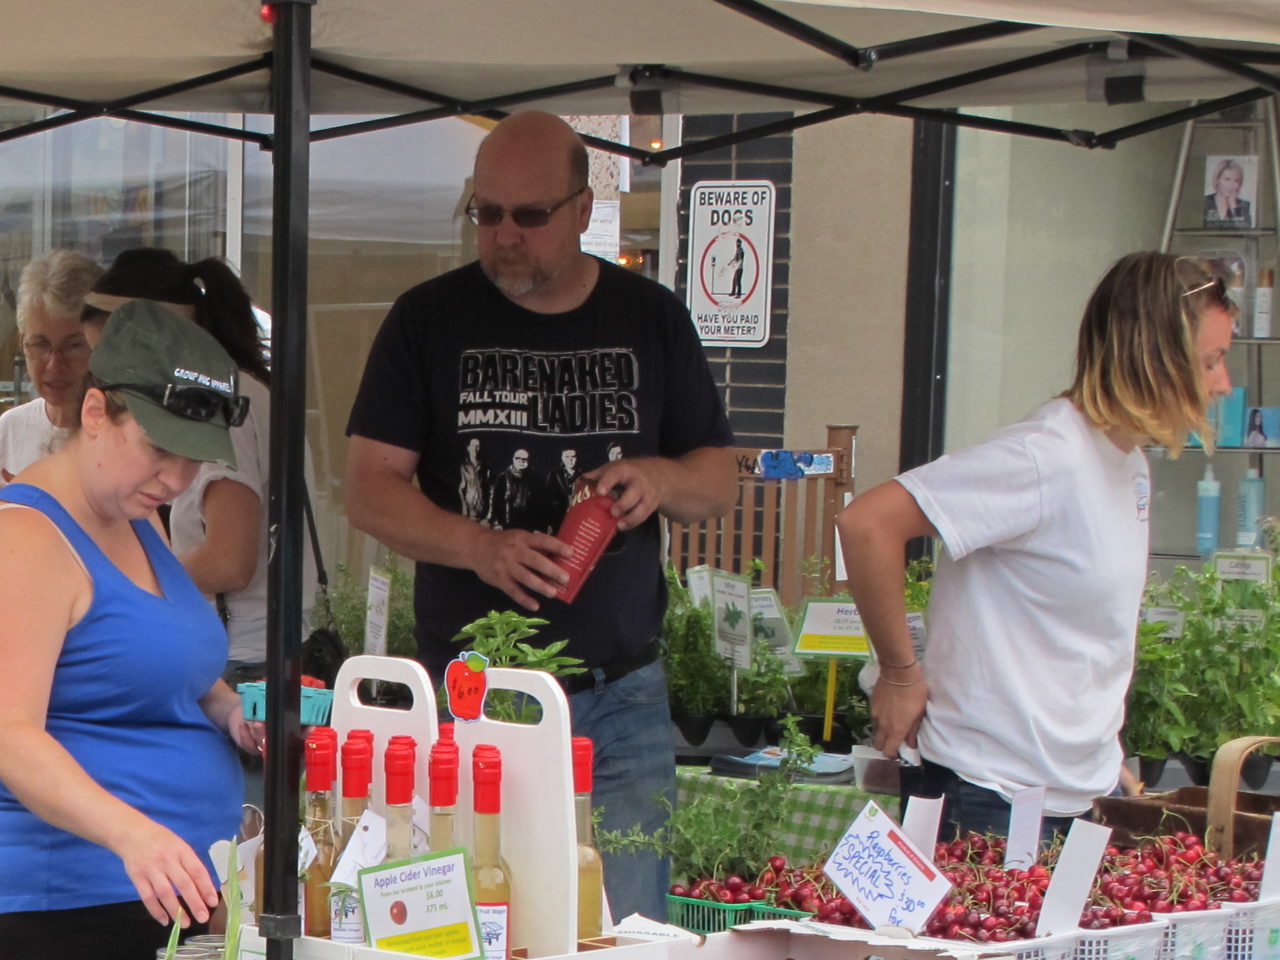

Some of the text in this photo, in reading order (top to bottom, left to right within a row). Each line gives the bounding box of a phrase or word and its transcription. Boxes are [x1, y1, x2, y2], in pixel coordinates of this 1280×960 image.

[699, 191, 767, 206] BEWARE OF
[697, 314, 759, 324] HAVE YOU PAID
[699, 325, 757, 336] YOUR METER?
[460, 352, 639, 394] BARENAKED
[460, 391, 529, 405] FALL TOUR
[458, 409, 528, 427] MMXIII
[531, 393, 639, 432] LADIES
[843, 843, 880, 888] SPECIAL
[867, 830, 913, 886] Raspberries
[374, 863, 455, 889] Apple Cider Vinegar
[426, 889, 443, 900] $6.00
